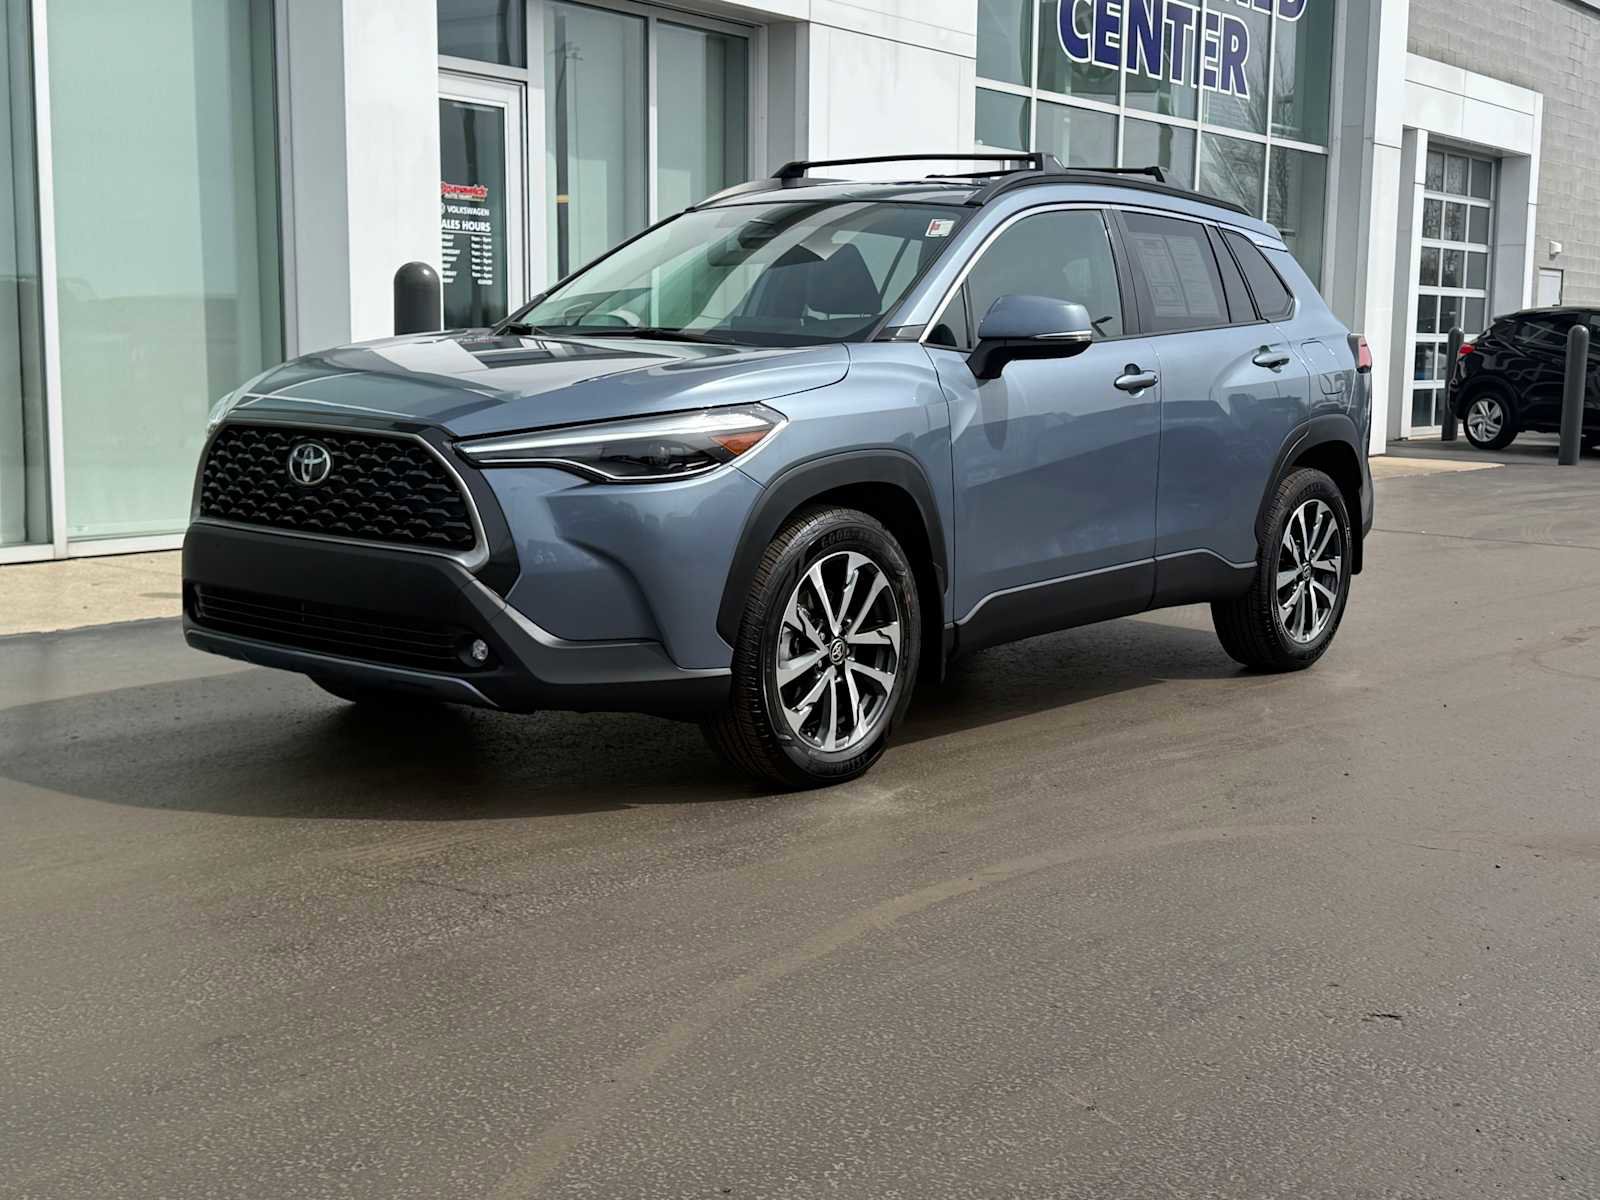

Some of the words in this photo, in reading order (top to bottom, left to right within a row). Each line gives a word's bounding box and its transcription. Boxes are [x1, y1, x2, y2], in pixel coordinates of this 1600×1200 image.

[1058, 0, 1249, 99] CENTER
[447, 206, 489, 215] VOLKSWAGEN
[441, 219, 460, 229] ALES
[462, 221, 490, 231] HOURS
